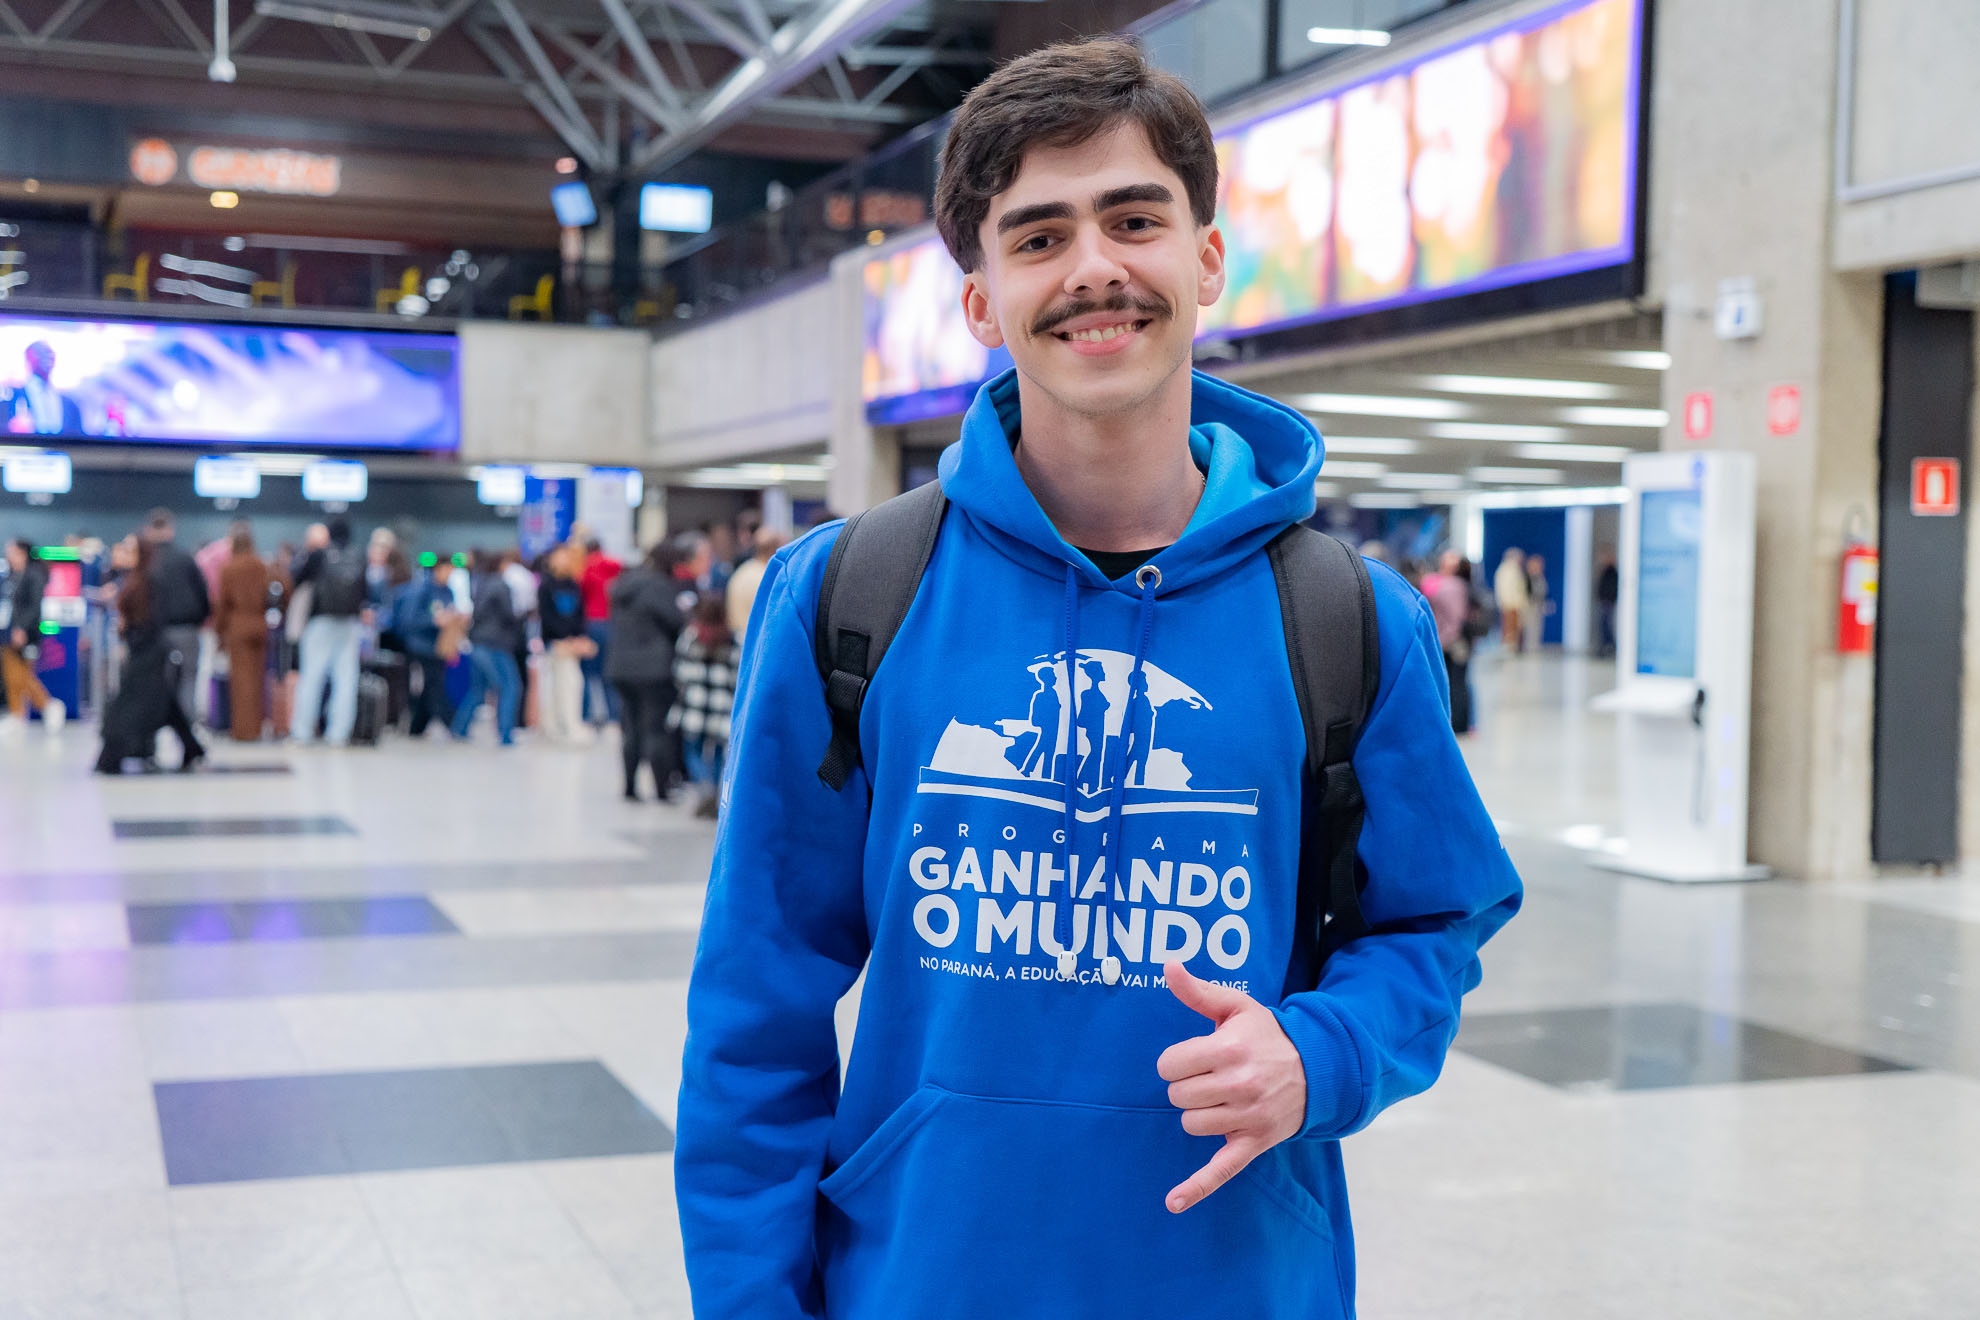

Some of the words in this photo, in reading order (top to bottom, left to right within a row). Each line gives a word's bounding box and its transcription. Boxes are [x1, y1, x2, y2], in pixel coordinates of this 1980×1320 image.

[908, 846, 1251, 911] GANHANDO
[912, 893, 960, 948] O
[975, 897, 1251, 970] MUNDO
[920, 956, 939, 970] NO
[942, 958, 1000, 981] PARANÁ,
[1005, 966, 1016, 980] A
[1021, 966, 1104, 986] EDUCAÇÃ
[1120, 973, 1148, 988] VAI
